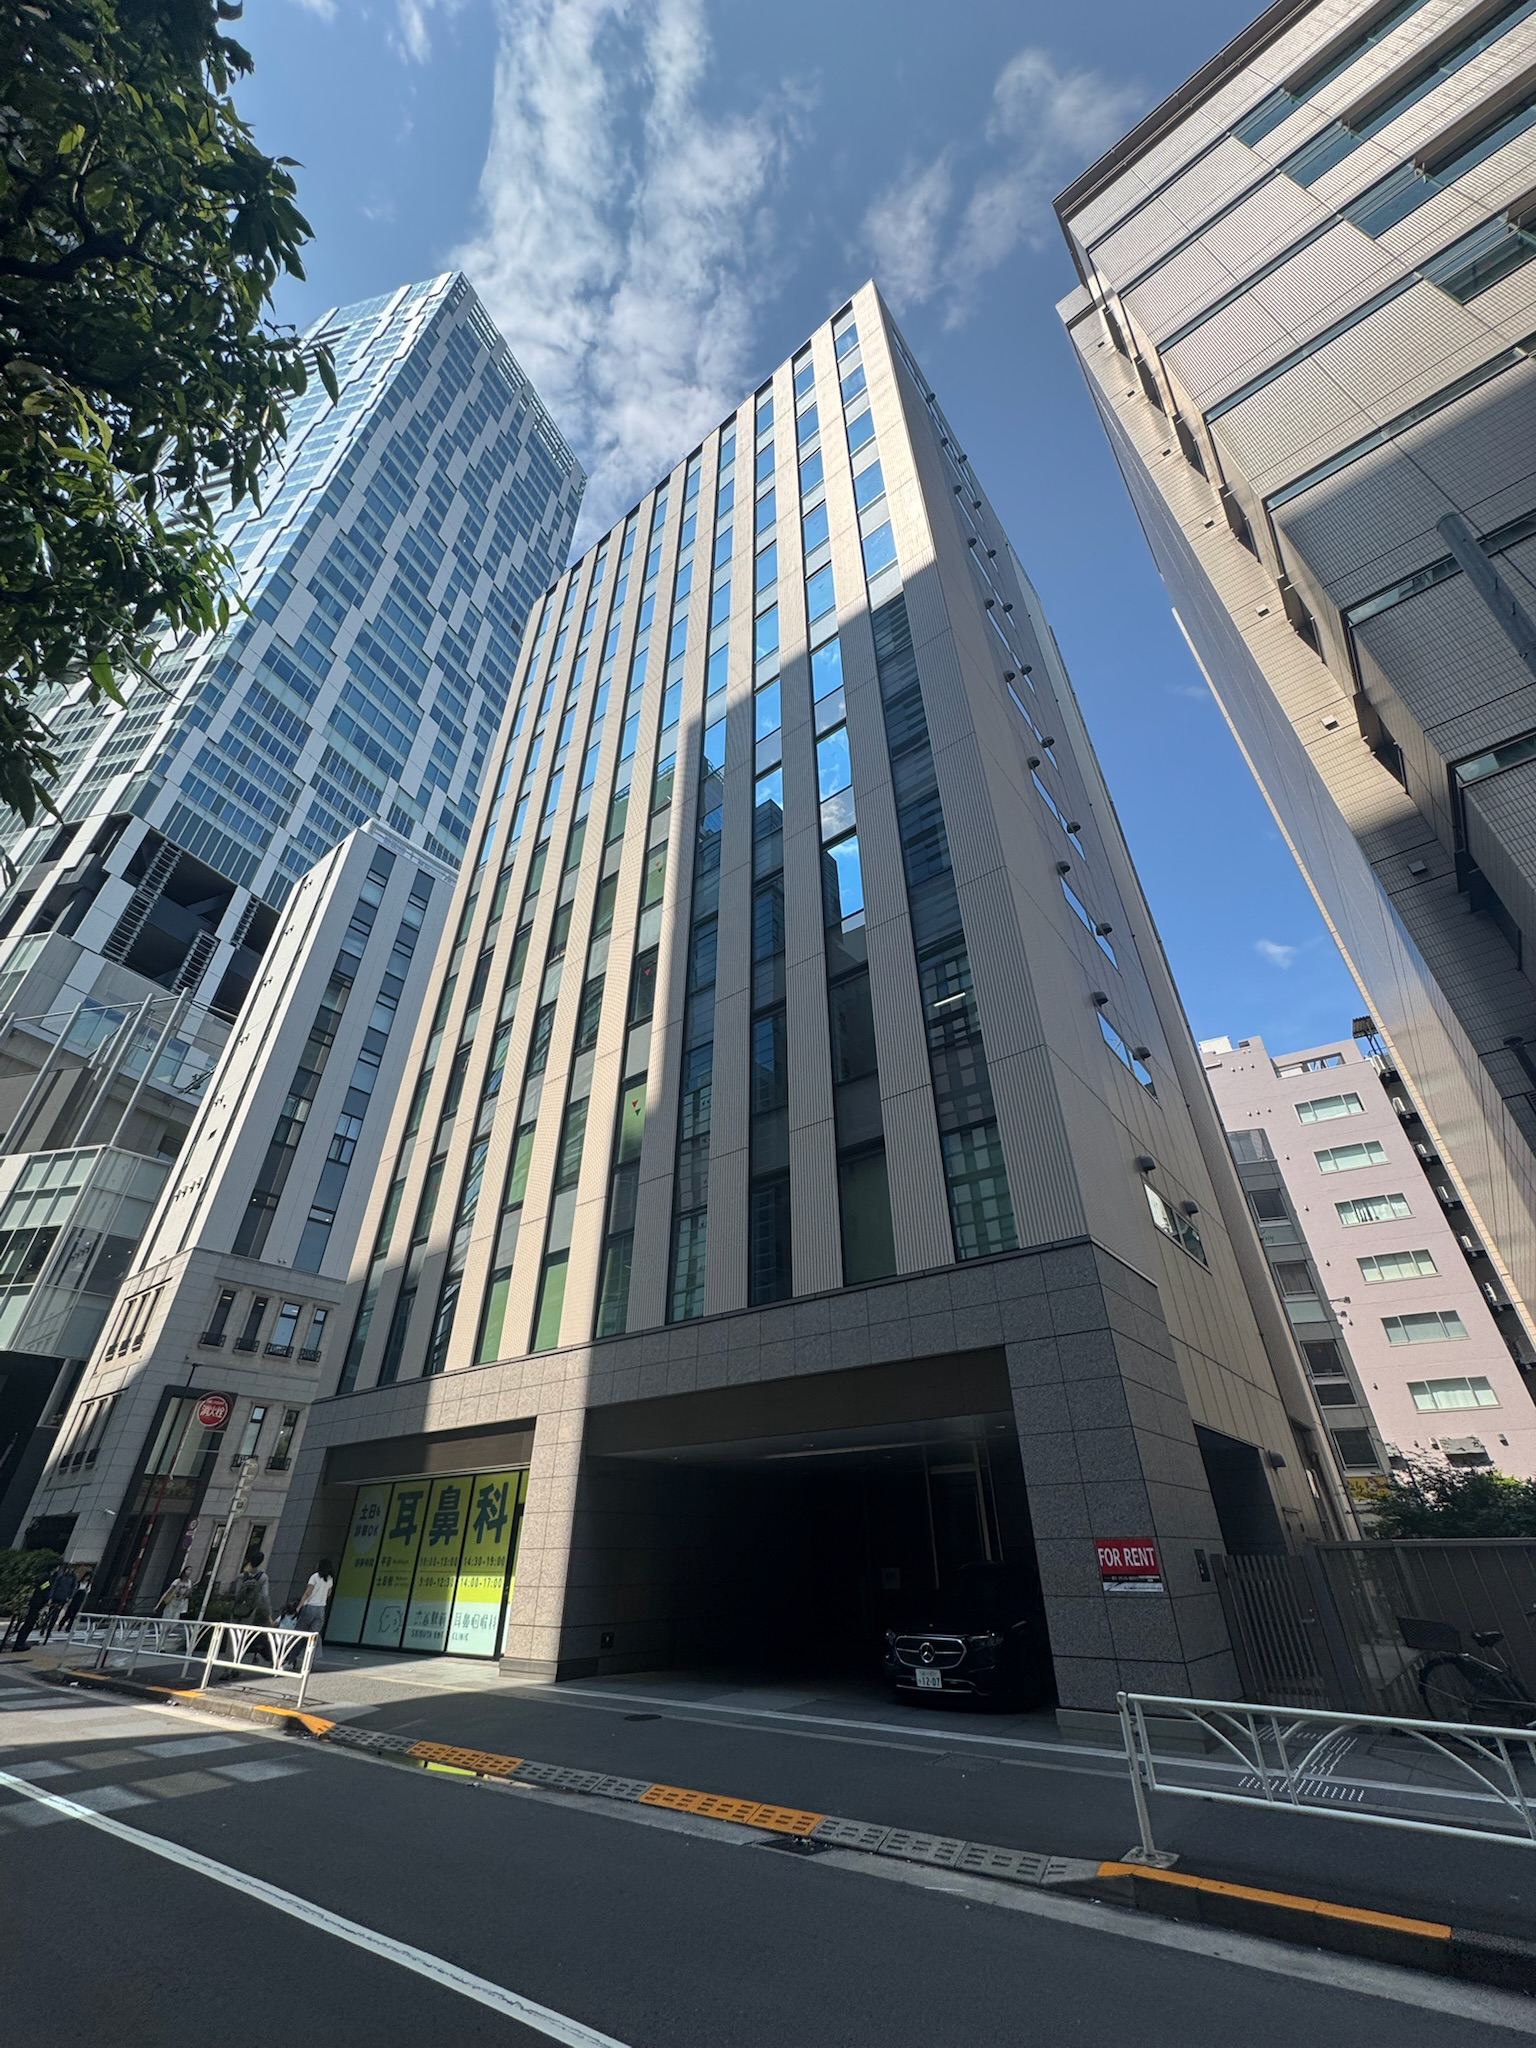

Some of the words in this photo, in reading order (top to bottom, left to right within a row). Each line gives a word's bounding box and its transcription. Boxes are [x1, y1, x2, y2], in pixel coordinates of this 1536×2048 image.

[200, 1404, 225, 1418] 消火栓
[389, 1481, 509, 1547] 耳鼻科
[463, 1556, 506, 1567] 14:30-19:00
[1098, 1548, 1122, 1567] FOR
[1123, 1547, 1154, 1567] RENT
[460, 1577, 502, 1588] 14:00-17:00
